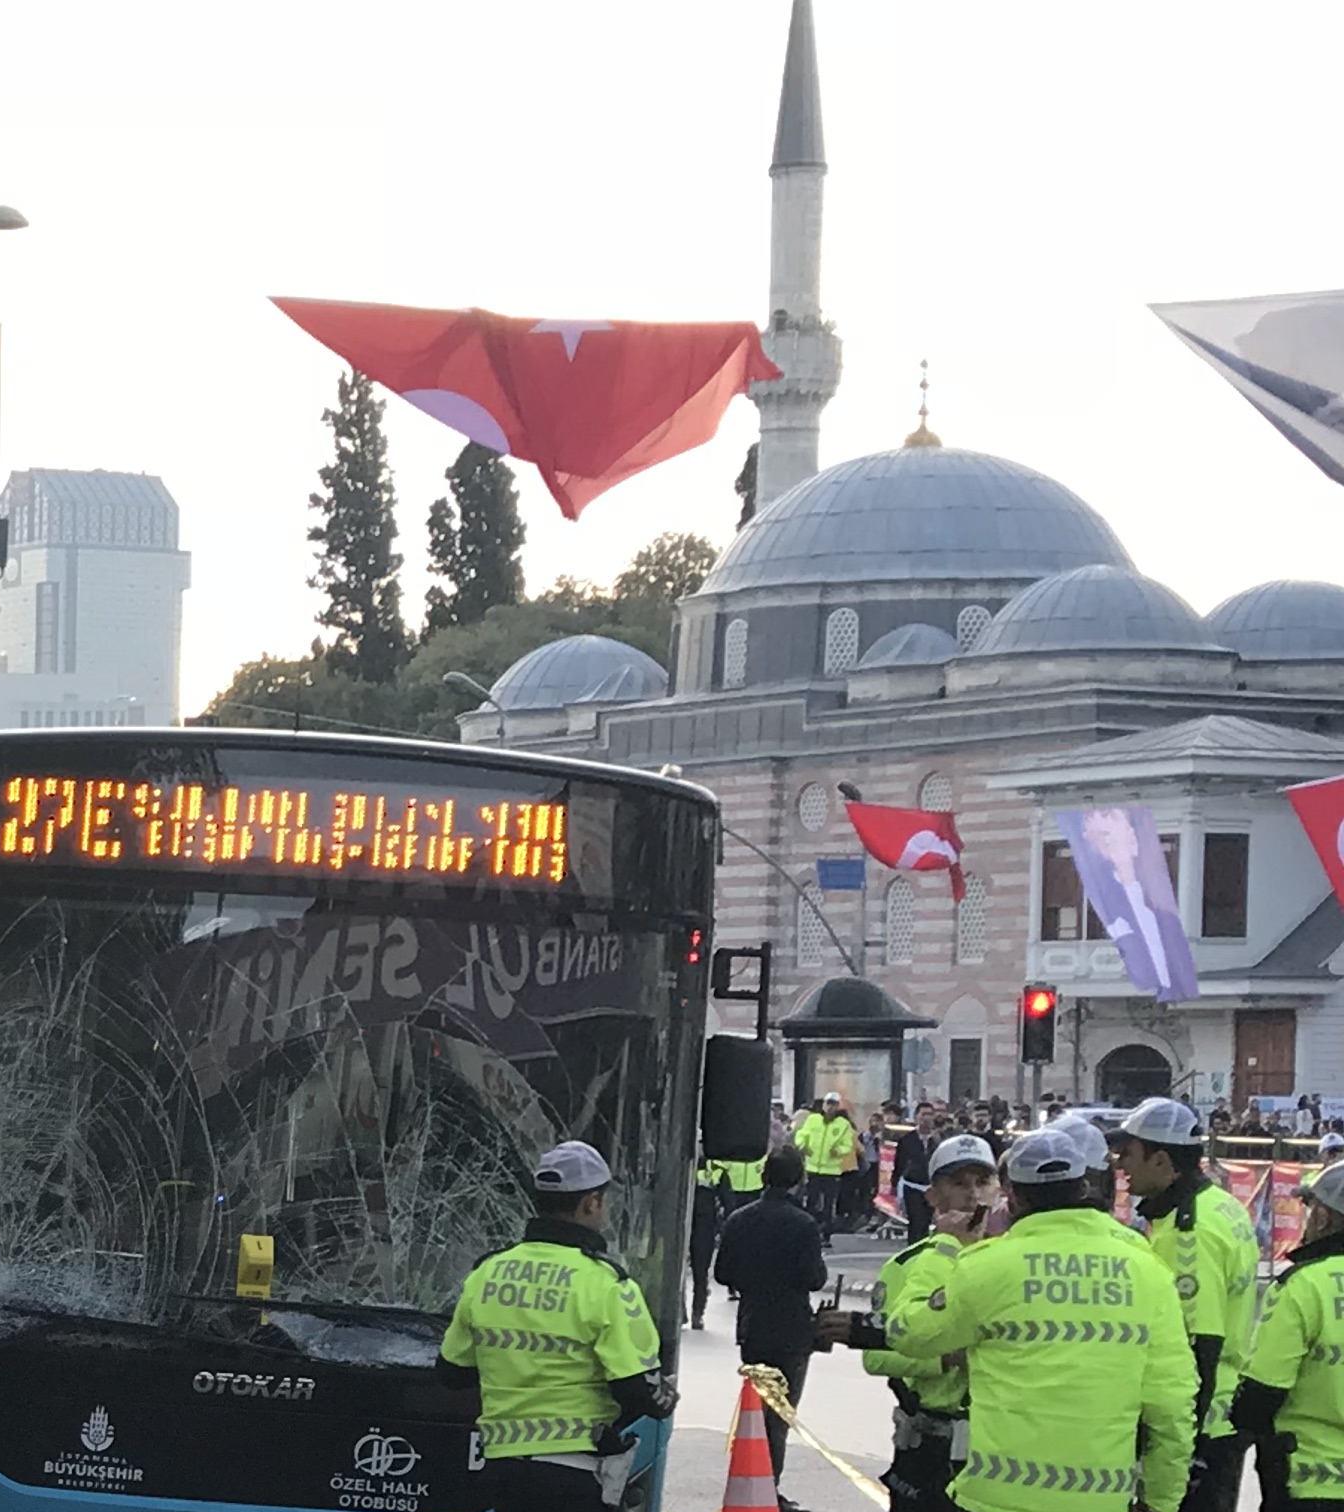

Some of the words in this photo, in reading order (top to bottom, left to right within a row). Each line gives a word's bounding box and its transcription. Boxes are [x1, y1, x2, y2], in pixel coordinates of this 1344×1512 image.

[192, 1371, 316, 1400] OTOKAR
[44, 1460, 143, 1481] BÜYÜKŞEHİR
[330, 1473, 376, 1493] ÖZEL
[382, 1479, 429, 1497] HALK
[339, 1494, 418, 1512] OTOBÜSÜ
